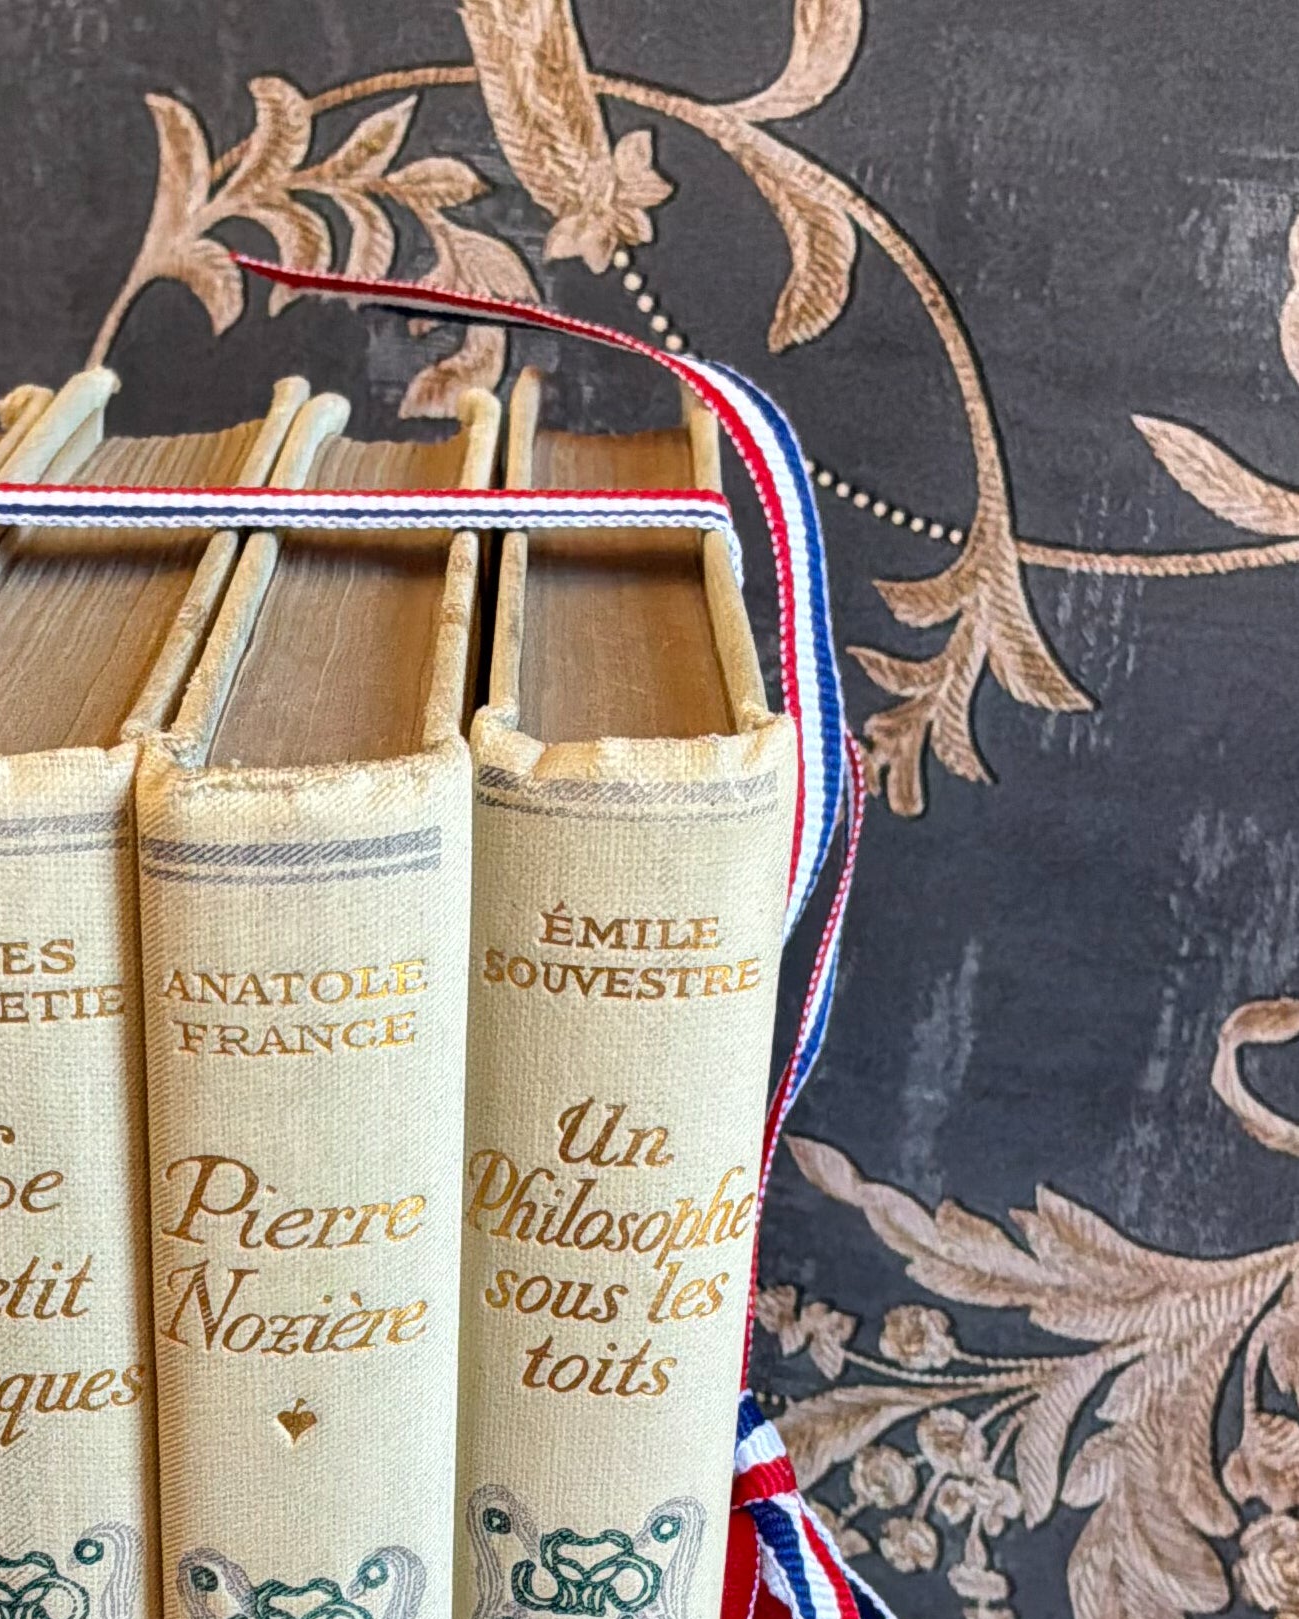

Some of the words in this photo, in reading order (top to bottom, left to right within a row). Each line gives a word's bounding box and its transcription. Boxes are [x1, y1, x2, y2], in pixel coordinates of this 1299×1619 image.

[540, 902, 719, 950] ÉMILE
[162, 959, 429, 1005] ANATOLE
[483, 949, 762, 1000] SOUVESTRE
[170, 1012, 417, 1055] FRANCE
[558, 1097, 673, 1167] Un
[161, 1154, 427, 1252] Pierre
[465, 1148, 756, 1269] Philosophe
[160, 1260, 428, 1355] Nozière
[485, 1267, 628, 1324] sous
[649, 1261, 731, 1324] les
[522, 1334, 678, 1397] toits
